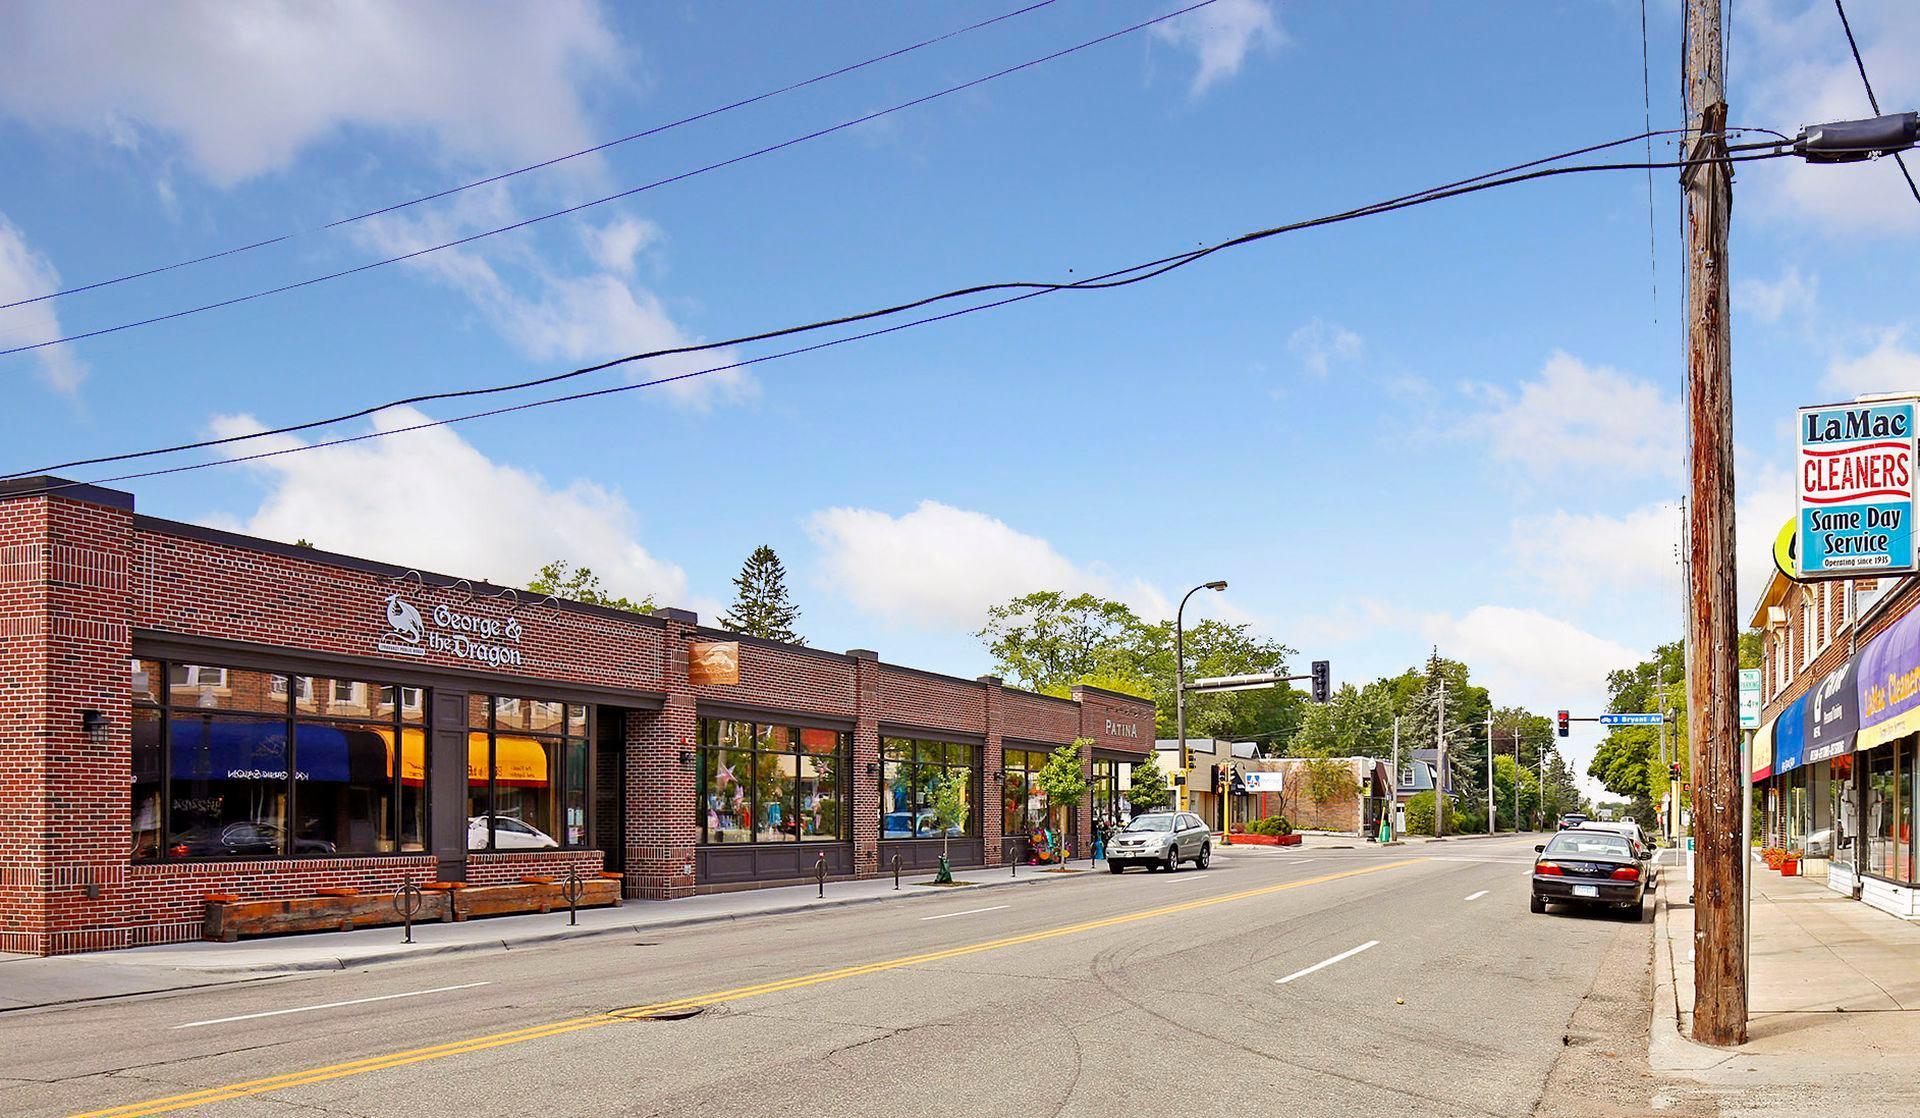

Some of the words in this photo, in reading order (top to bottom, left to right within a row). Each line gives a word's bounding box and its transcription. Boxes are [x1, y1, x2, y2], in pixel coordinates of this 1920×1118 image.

[1807, 410, 1907, 442] LaMac
[1804, 453, 1910, 492] CLEANERS
[1811, 510, 1860, 532] Same
[1867, 507, 1902, 529] Day
[1824, 531, 1888, 554] Service
[1824, 558, 1856, 567] Operating
[1874, 556, 1889, 564] 1935
[433, 605, 501, 639] George
[505, 617, 522, 643] &
[428, 632, 452, 652] the
[451, 635, 522, 667] Dragon
[1105, 719, 1138, 738] PATINA
